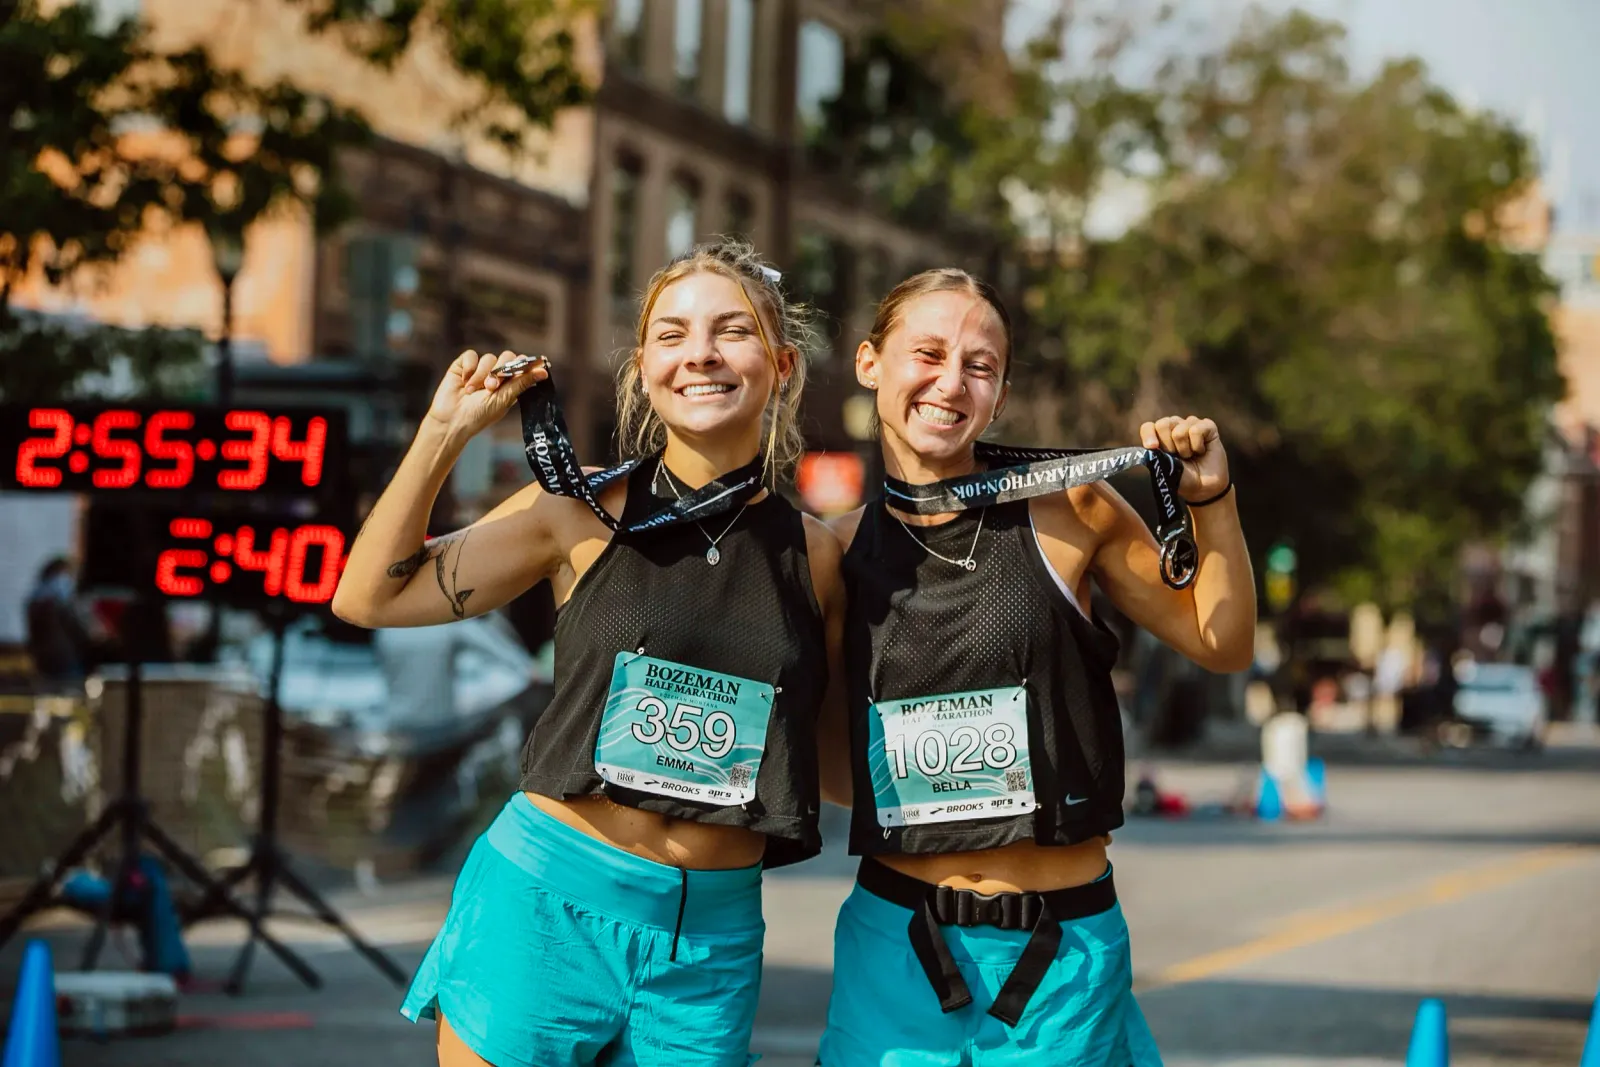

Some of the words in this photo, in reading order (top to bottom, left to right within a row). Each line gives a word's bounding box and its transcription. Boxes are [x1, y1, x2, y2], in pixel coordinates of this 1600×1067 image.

[1087, 452, 1131, 475] HALF
[155, 518, 347, 604] 2:40
[646, 663, 742, 696] BOZEMAN
[644, 678, 674, 691] HALF
[674, 686, 738, 705] MARATHON
[900, 694, 993, 716] BOZEMAN
[902, 715, 927, 726] HAL
[932, 708, 993, 721] MARATHON
[631, 696, 737, 759] 359
[885, 722, 1017, 779] 1028
[656, 755, 695, 773] EMMA
[661, 782, 701, 795] BROOKS
[708, 789, 732, 798] aprs
[932, 780, 972, 794] BELLA
[947, 803, 984, 813] BROOKS
[991, 798, 1013, 808] aprs
